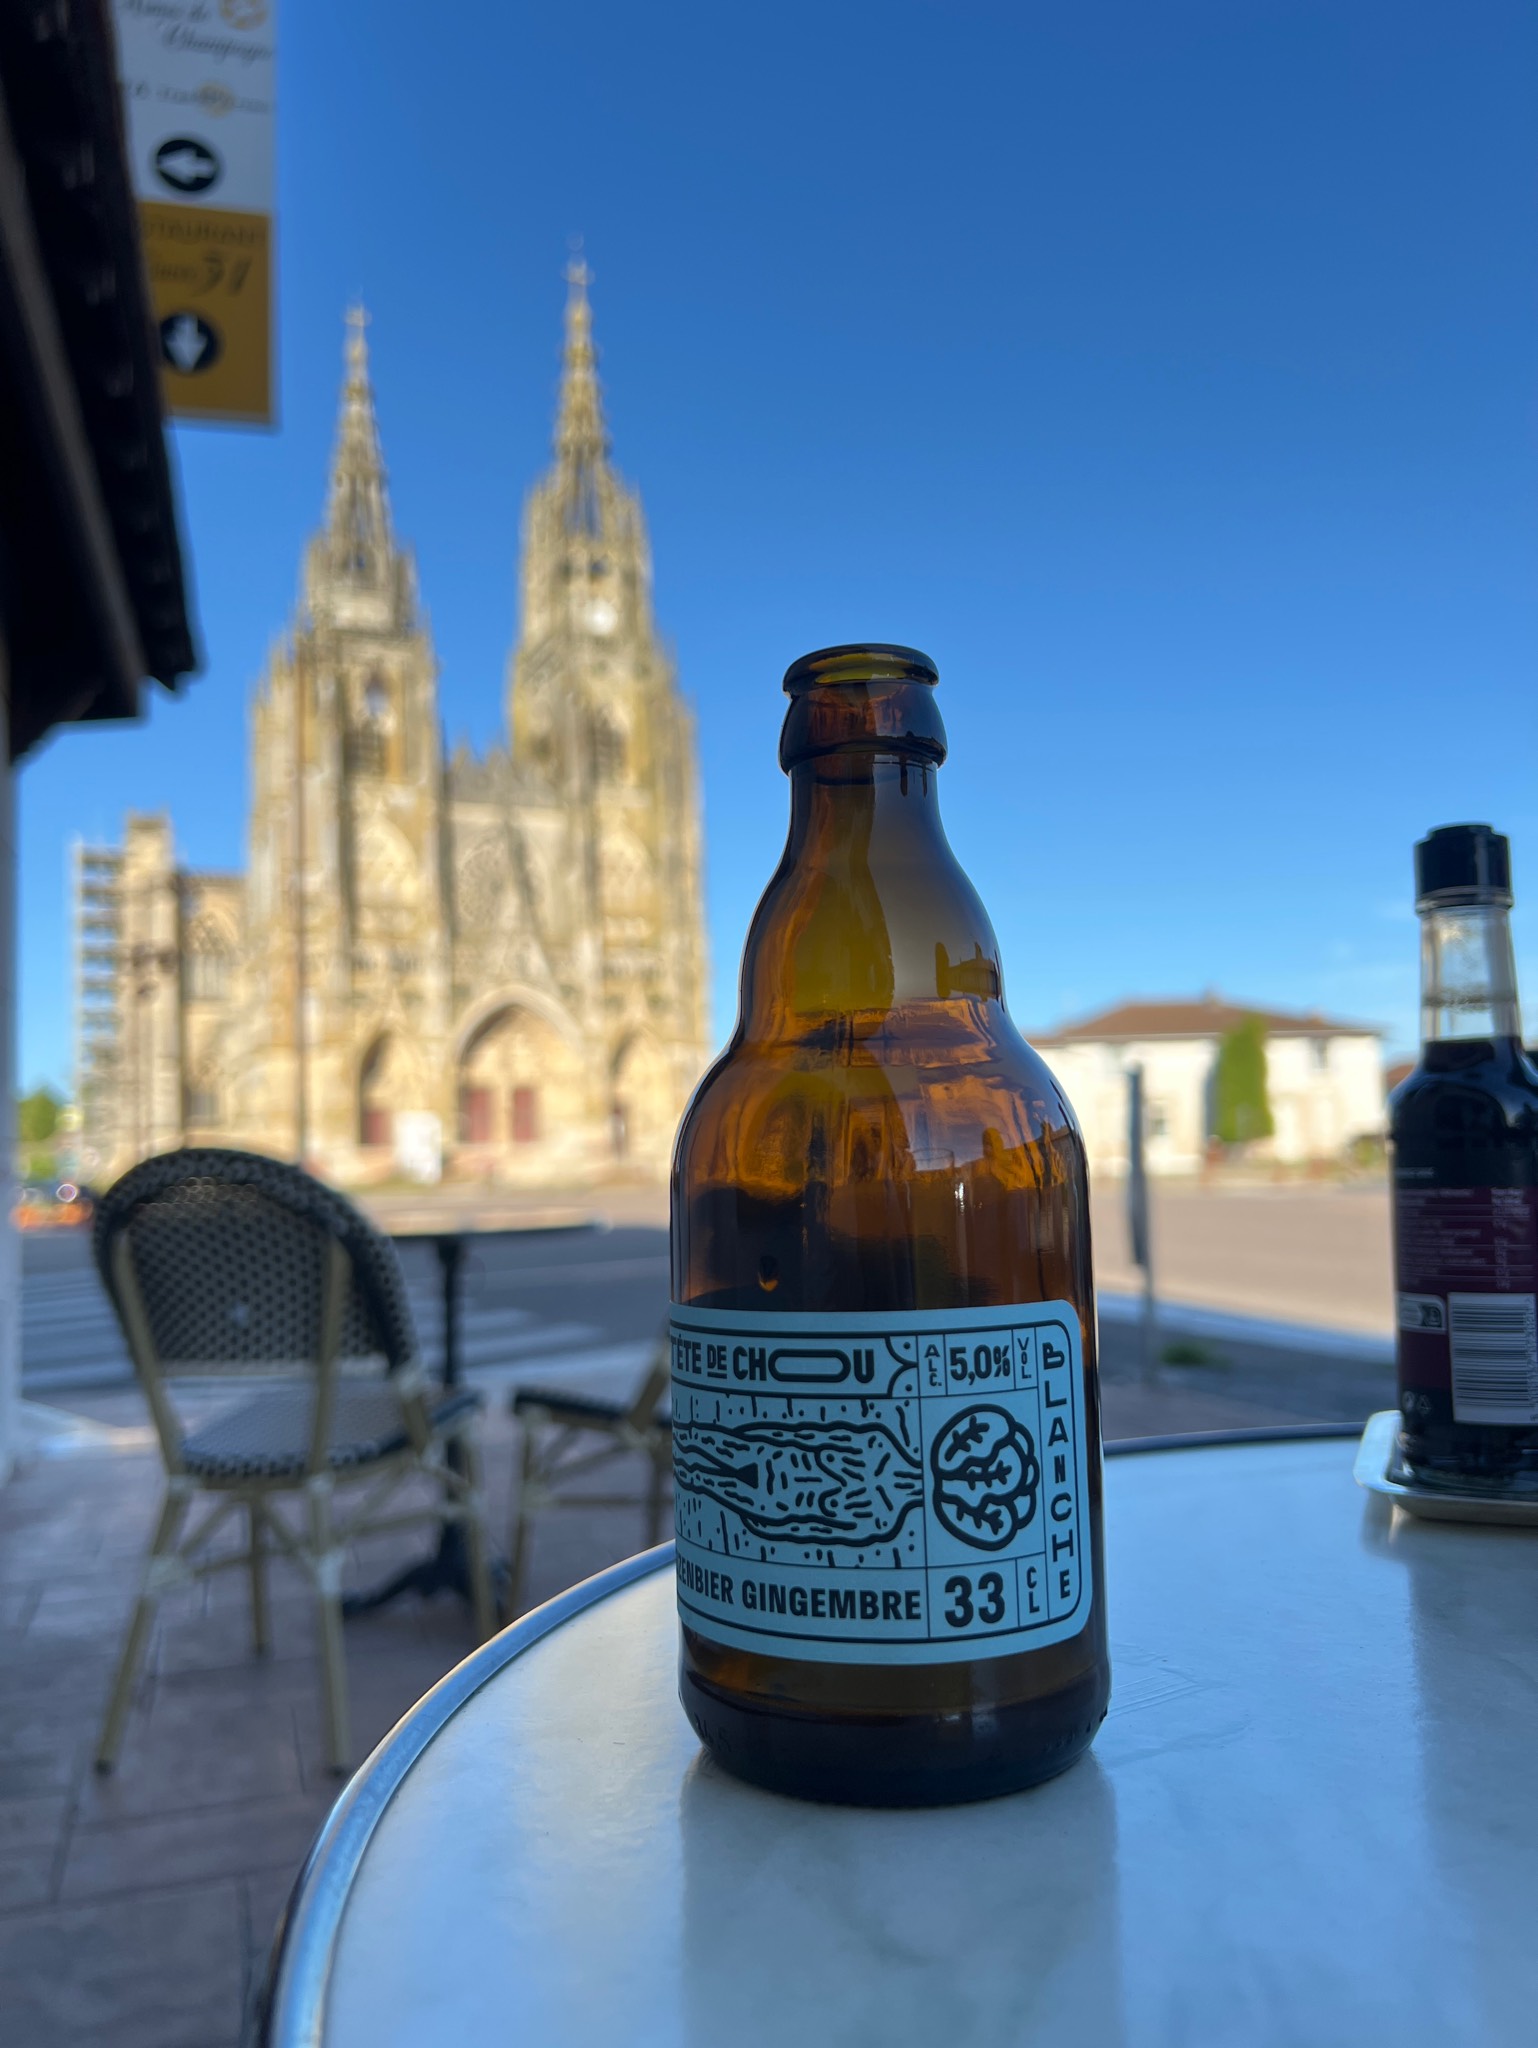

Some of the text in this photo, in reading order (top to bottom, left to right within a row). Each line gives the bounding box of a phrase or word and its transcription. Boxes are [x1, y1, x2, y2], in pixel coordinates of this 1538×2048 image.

[707, 1347, 727, 1379] DE
[733, 1346, 875, 1384] CHOU
[950, 1344, 1011, 1386] 5,0%
[1042, 1342, 1075, 1600] BLANCHE
[742, 1578, 922, 1622] GINGEMBRE
[944, 1571, 1006, 1628] 33
[1026, 1566, 1040, 1613] CL
